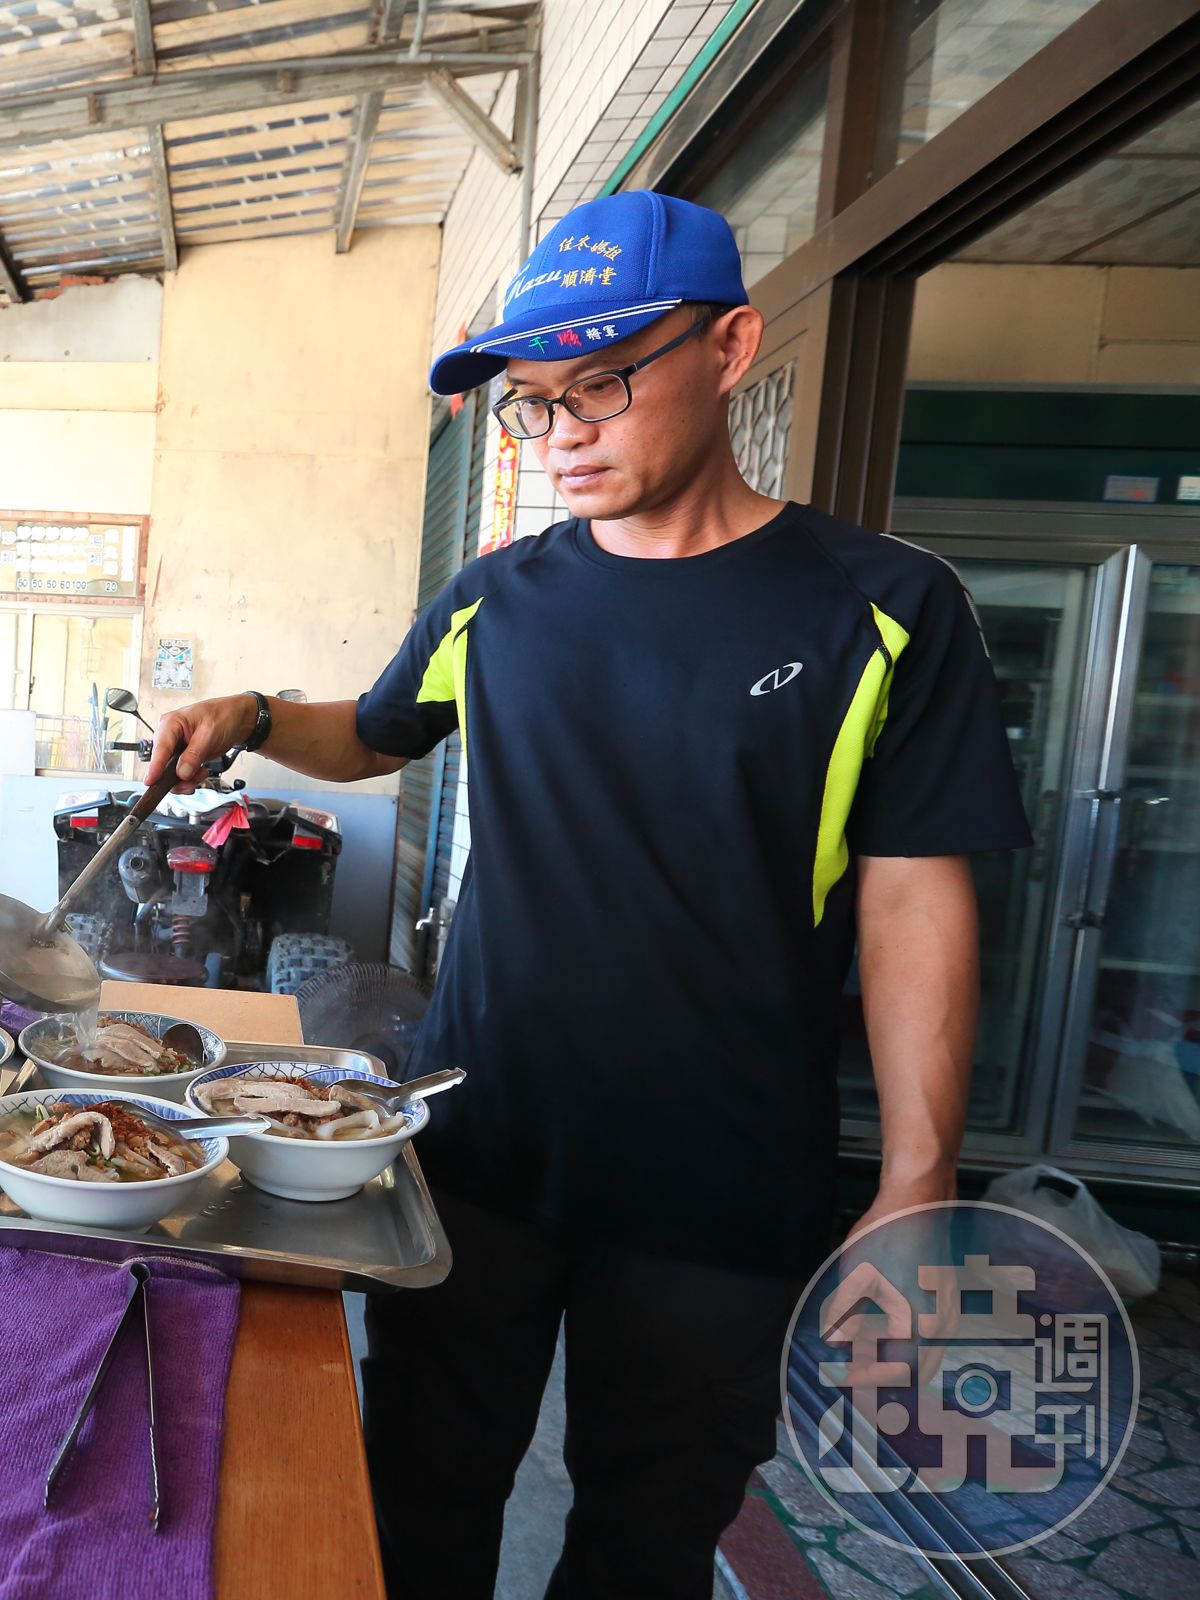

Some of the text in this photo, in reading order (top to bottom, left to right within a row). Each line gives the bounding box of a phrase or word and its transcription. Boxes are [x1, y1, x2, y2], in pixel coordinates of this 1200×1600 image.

[559, 234, 622, 261] 佳冬媽祖
[560, 266, 617, 288] 順濟堂
[104, 581, 117, 592] 20
